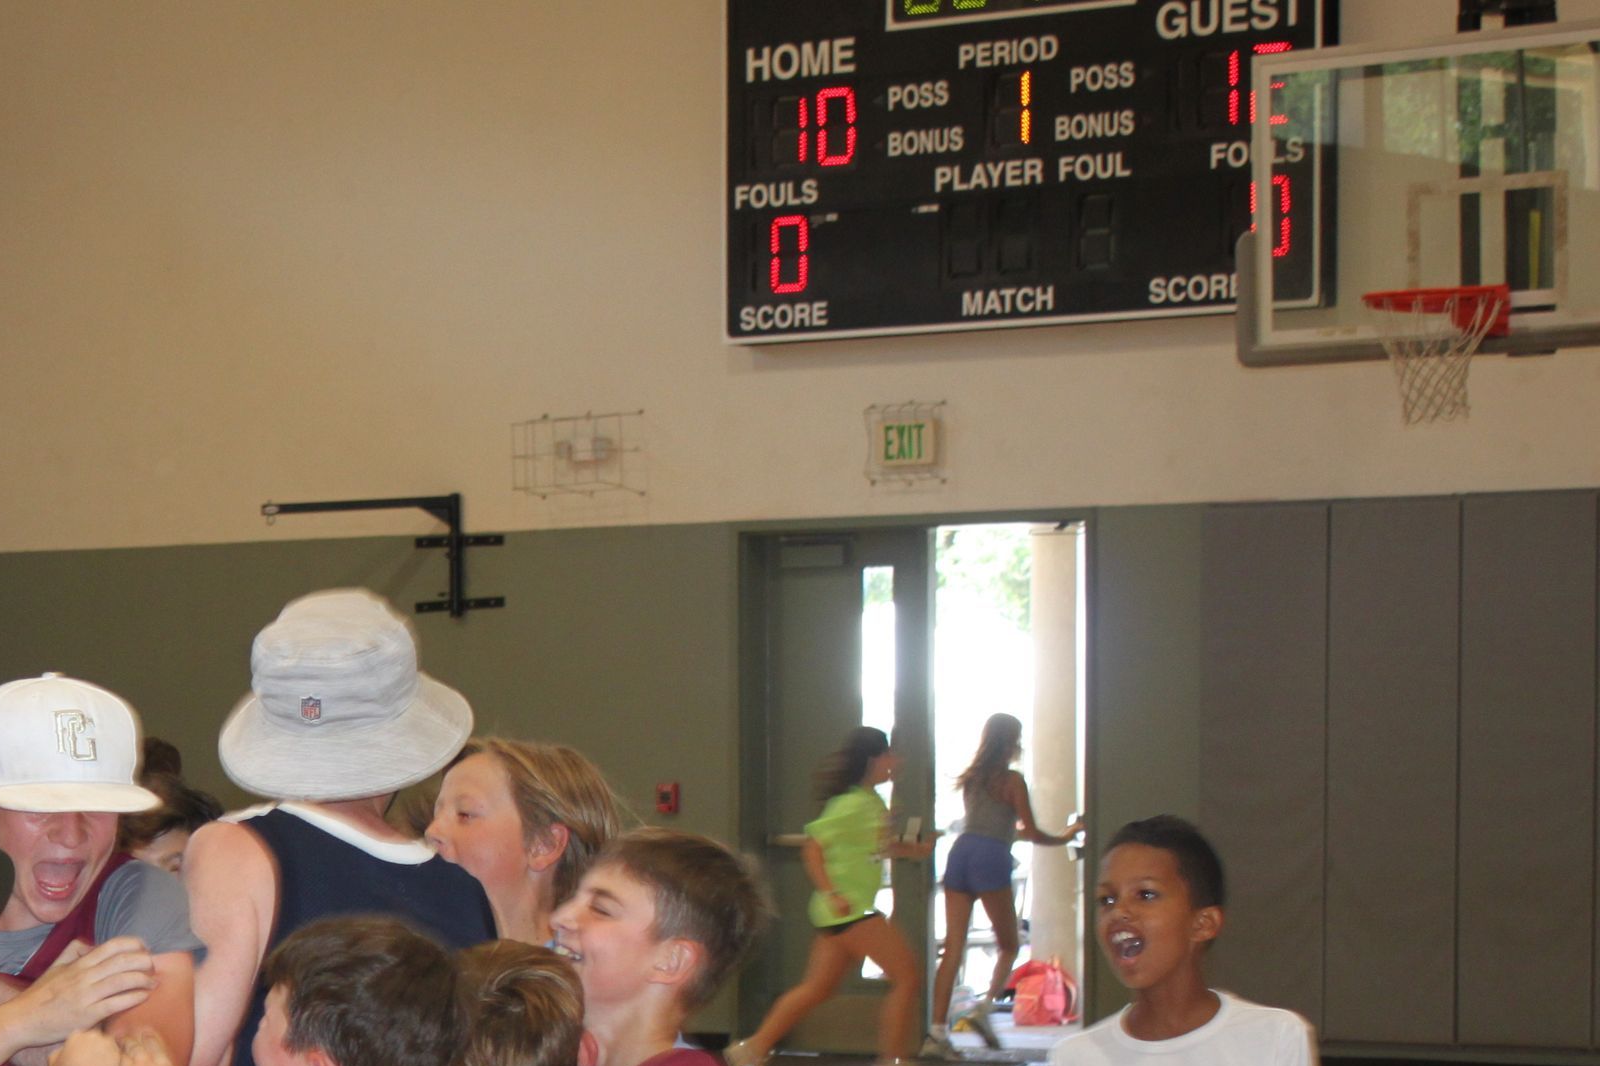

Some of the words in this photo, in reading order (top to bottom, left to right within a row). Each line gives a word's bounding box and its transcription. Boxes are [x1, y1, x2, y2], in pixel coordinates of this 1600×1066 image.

[1156, 0, 1297, 40] GUEST
[746, 38, 856, 82] HOME
[958, 35, 1058, 69] PERIOD
[1070, 62, 1135, 93] POSS
[888, 81, 949, 111] POSS
[1020, 70, 1031, 144] 1
[798, 86, 856, 165] 10
[888, 127, 964, 157] BONUS
[1056, 110, 1135, 141] BONUS
[1210, 136, 1304, 170] FOLS
[935, 159, 1043, 192] PLAYER
[1059, 152, 1131, 182] FOUL
[735, 178, 818, 209] FOULS
[770, 216, 808, 293] 0
[740, 302, 828, 331] SCORE
[962, 286, 1054, 316] MATCH
[884, 423, 925, 461] EXIT
